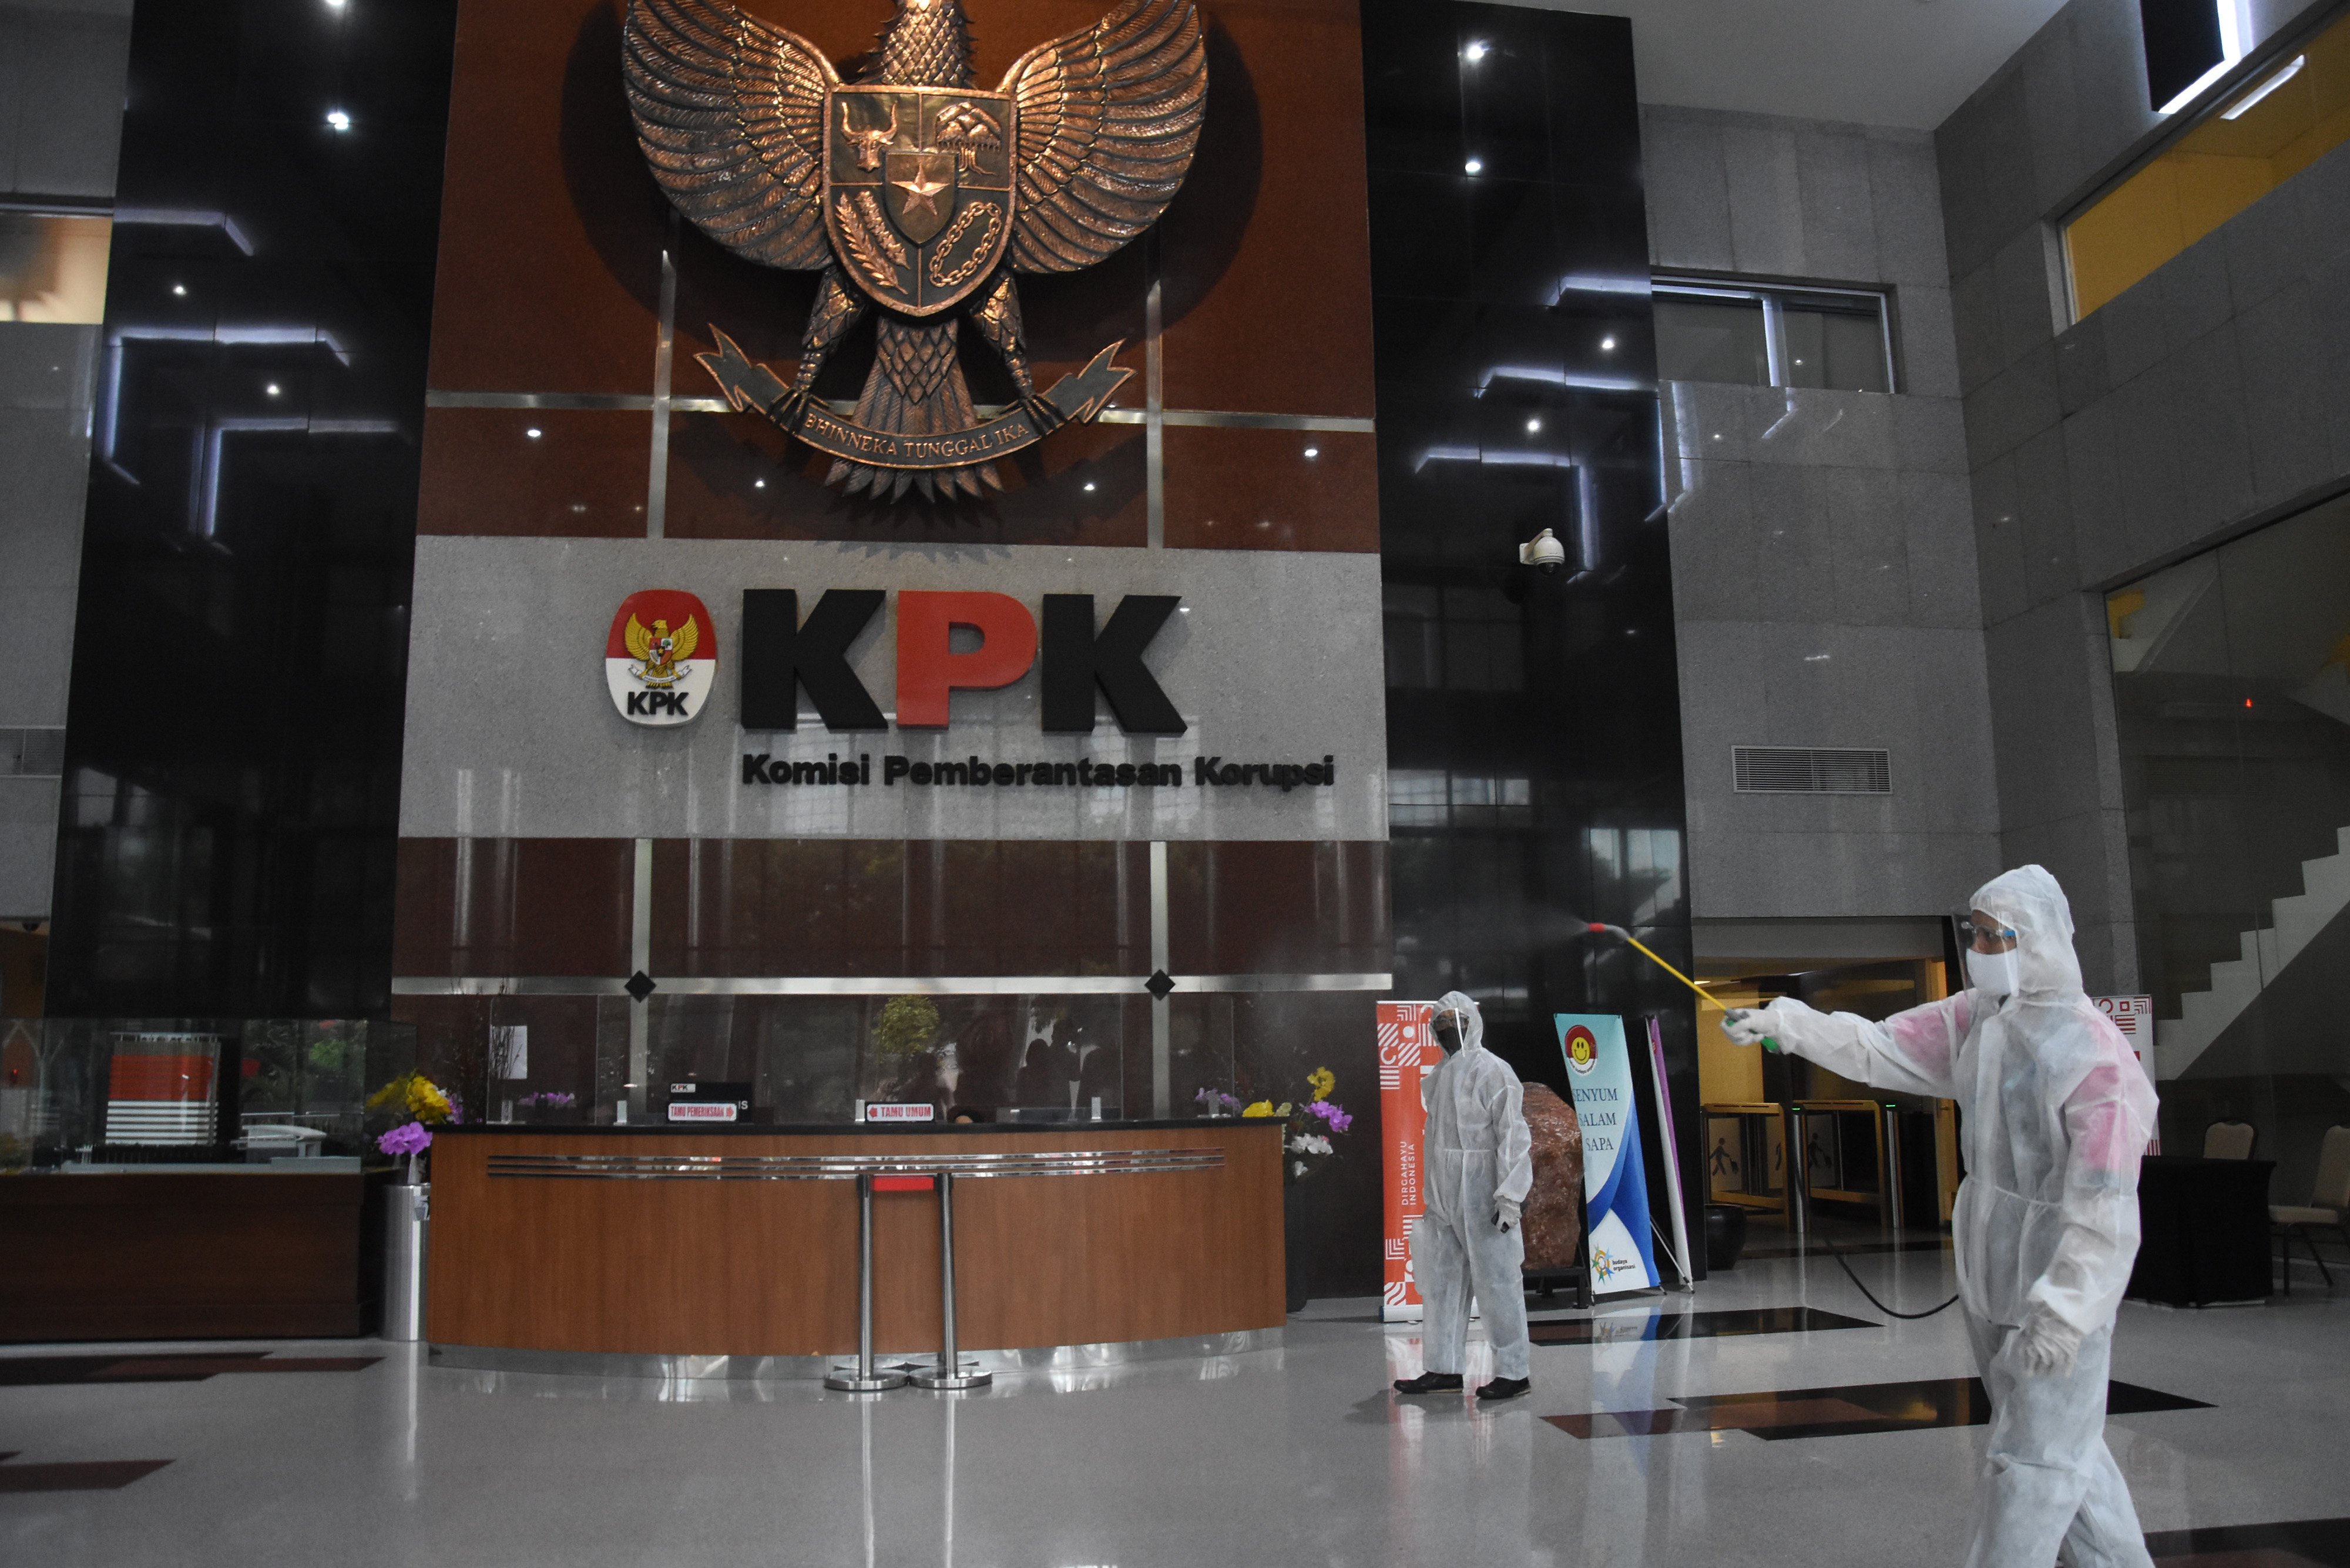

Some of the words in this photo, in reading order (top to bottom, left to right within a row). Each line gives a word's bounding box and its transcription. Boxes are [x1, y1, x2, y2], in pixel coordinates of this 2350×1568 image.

[803, 412, 898, 456] BHINNEKA
[904, 434, 993, 458] TUNGGAL
[995, 422, 1029, 445] IKA
[741, 589, 1187, 733] KPK
[627, 691, 689, 716] KPK
[743, 753, 870, 785] Komisi
[884, 756, 1181, 786] Pemberantasan
[1195, 755, 1334, 793] Korupsi
[1573, 1088, 1618, 1102] SENYUM
[671, 1106, 686, 1117] TAMU
[881, 1106, 903, 1117] TAMU
[905, 1106, 931, 1117] UMUM
[1579, 1112, 1617, 1126] SALAM
[1586, 1137, 1614, 1151] SAPA
[1400, 1141, 1409, 1206] DIRGAHAYU
[1408, 1144, 1416, 1205] INDONESIA
